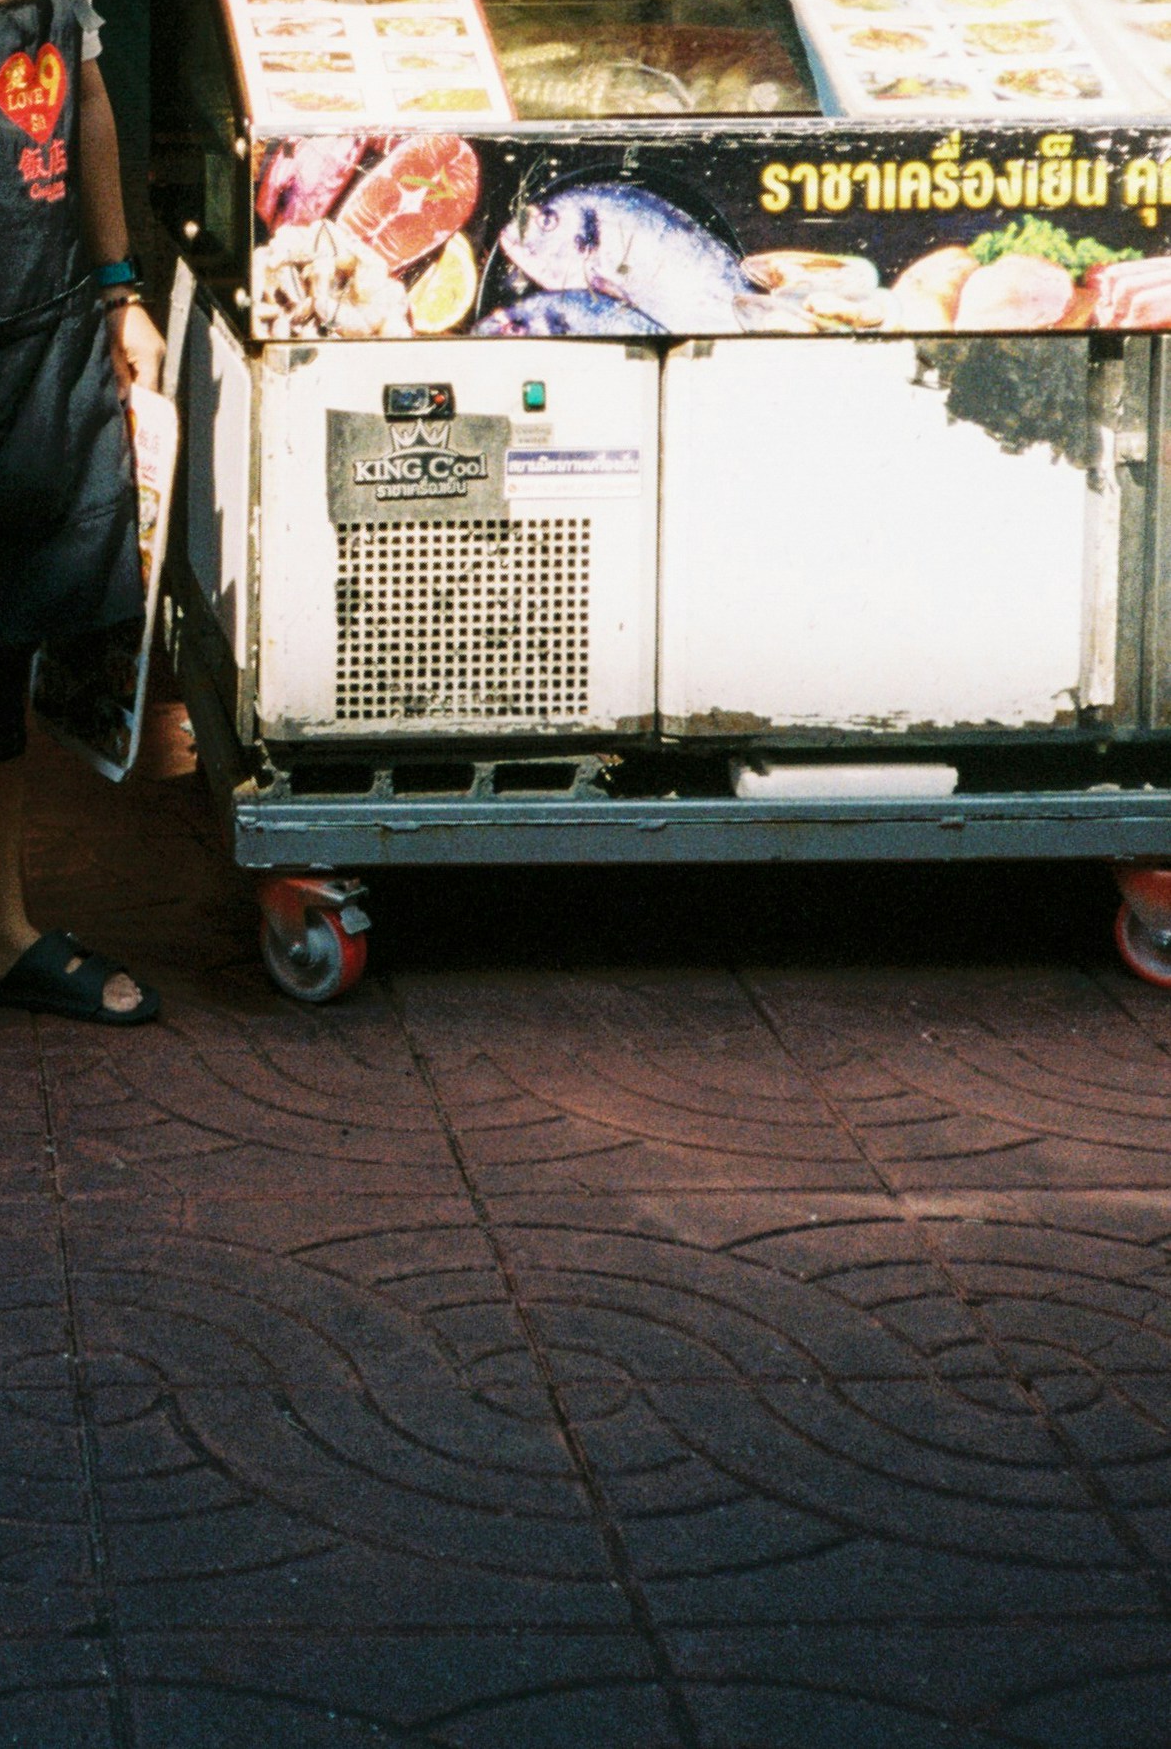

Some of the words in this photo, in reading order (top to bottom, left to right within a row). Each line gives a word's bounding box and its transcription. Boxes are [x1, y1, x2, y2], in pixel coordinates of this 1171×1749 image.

[7, 87, 45, 112] LOVE
[39, 53, 61, 107] 9
[761, 129, 1108, 212] ราชาเครื่องเย็น
[354, 458, 423, 482] KING
[428, 452, 488, 479] Cool
